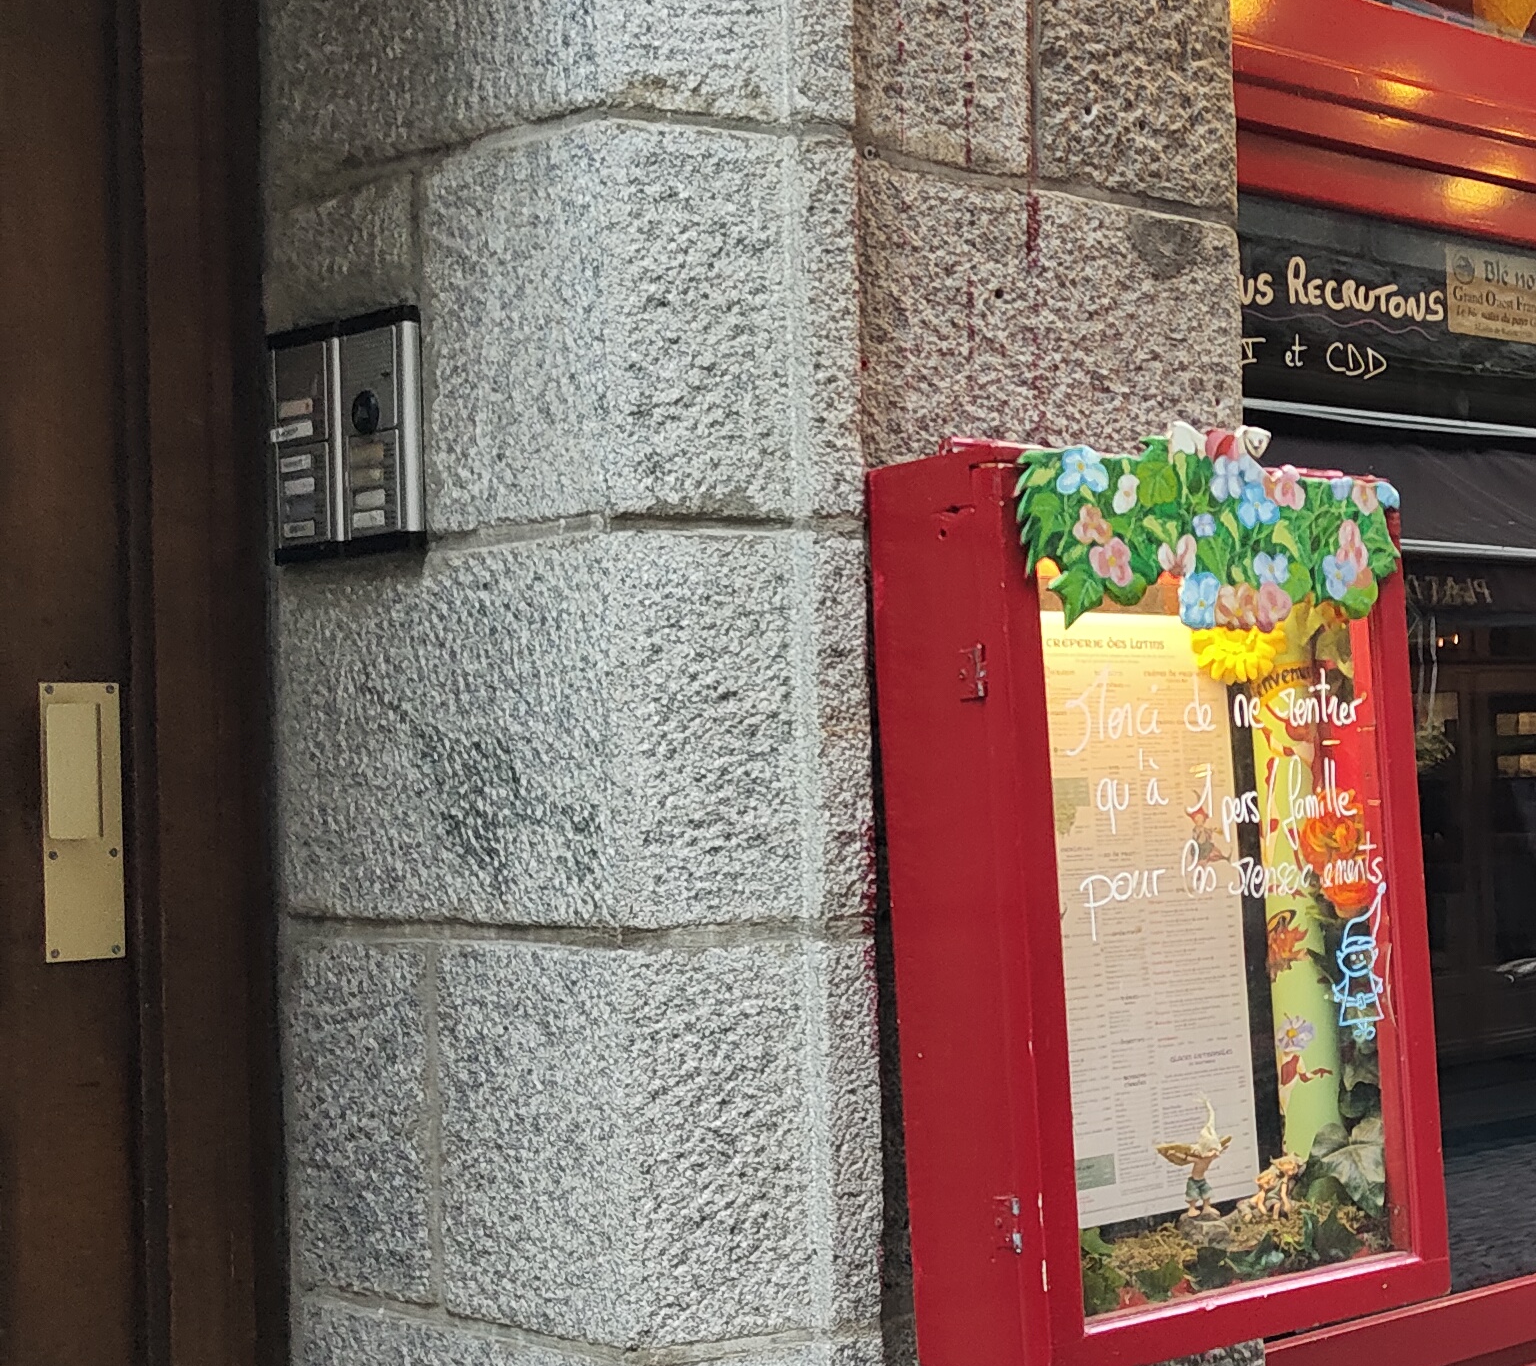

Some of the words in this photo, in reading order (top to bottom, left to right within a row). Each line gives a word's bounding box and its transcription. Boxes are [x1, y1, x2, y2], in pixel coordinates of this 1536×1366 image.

[1285, 334, 1308, 367] et
[1326, 342, 1387, 380] CDD
[1183, 673, 1217, 733] de
[1234, 693, 1265, 729] ne
[1079, 868, 1167, 942] pour
